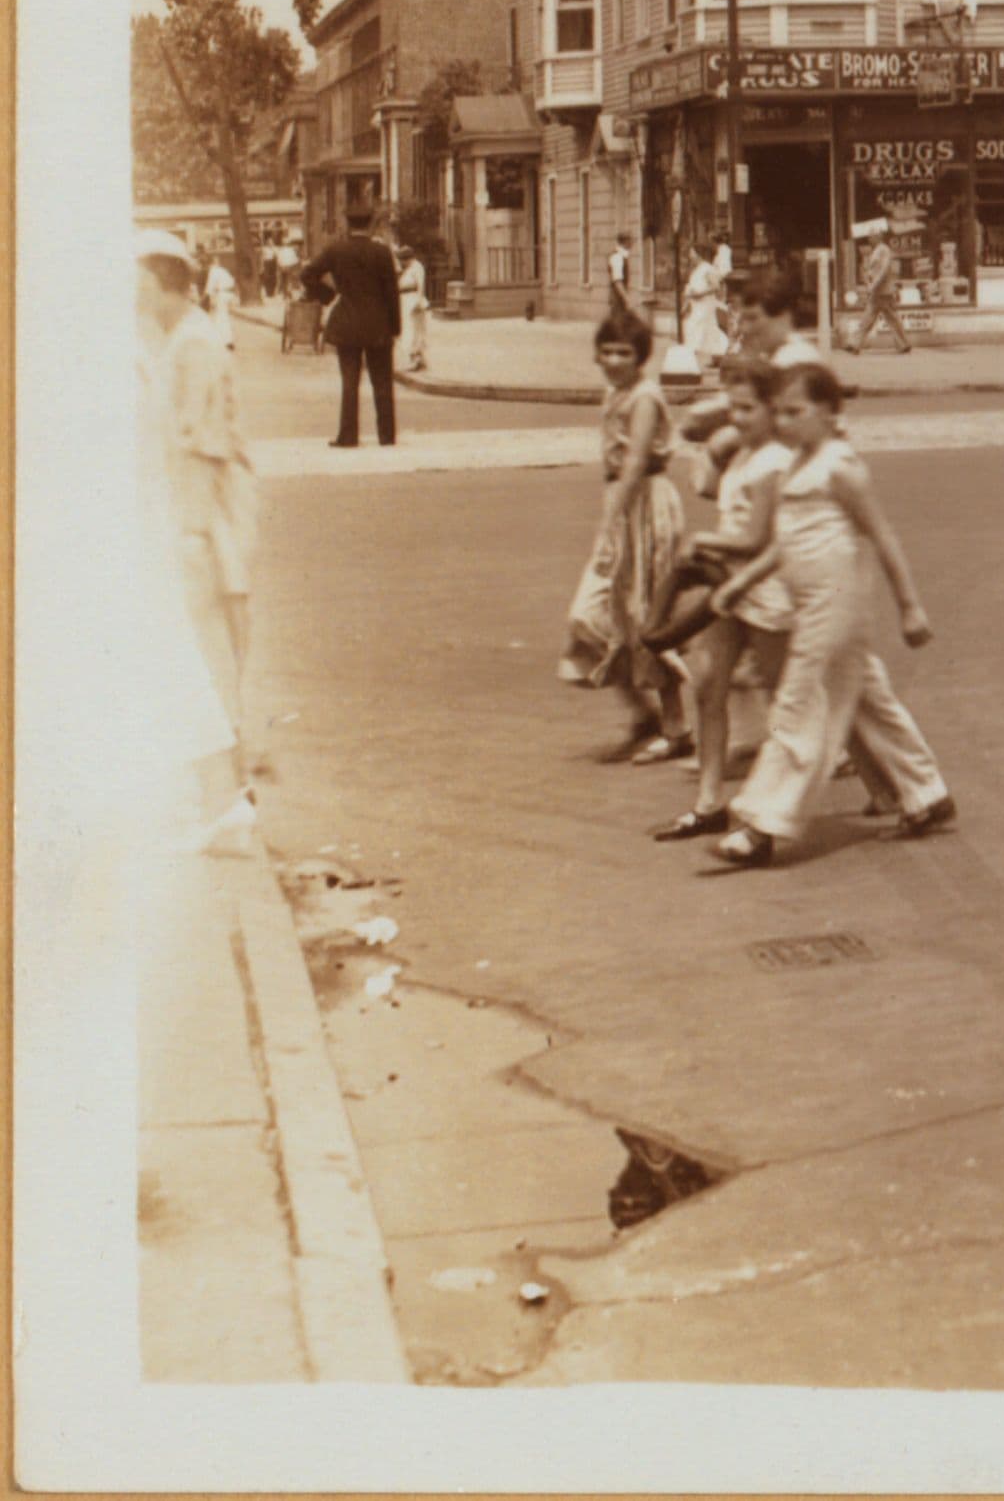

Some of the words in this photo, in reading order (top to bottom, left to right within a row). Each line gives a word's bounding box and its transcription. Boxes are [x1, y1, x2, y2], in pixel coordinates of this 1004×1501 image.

[853, 77, 882, 88] FOR
[853, 140, 955, 163] DRUGS
[869, 163, 935, 179] EX-LAX
